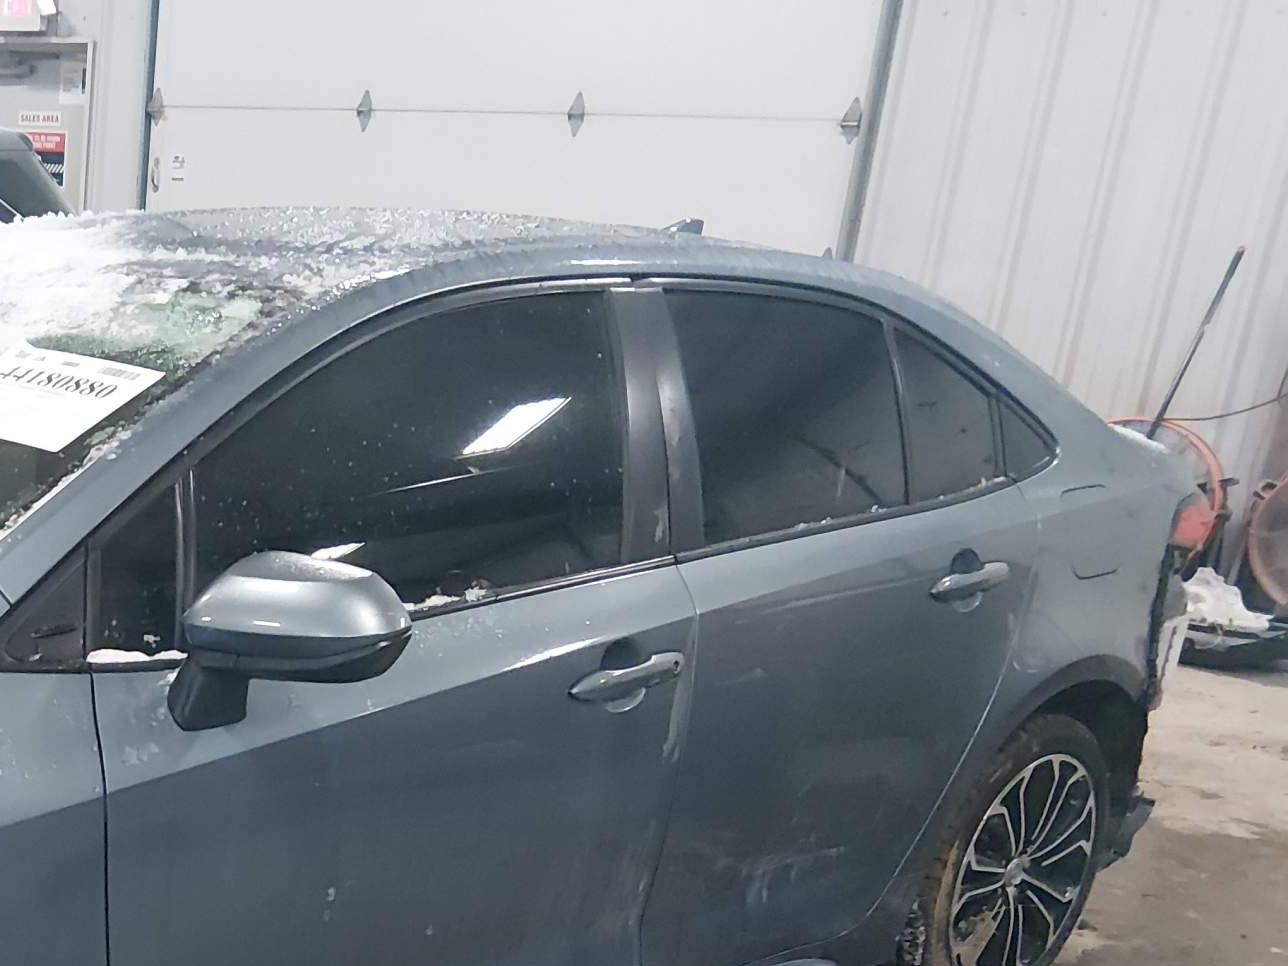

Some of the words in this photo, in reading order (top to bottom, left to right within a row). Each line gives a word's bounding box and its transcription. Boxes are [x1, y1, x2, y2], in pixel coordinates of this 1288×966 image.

[20, 114, 41, 123] SALES
[42, 114, 60, 123] AREA
[0, 365, 118, 399] 44180880
